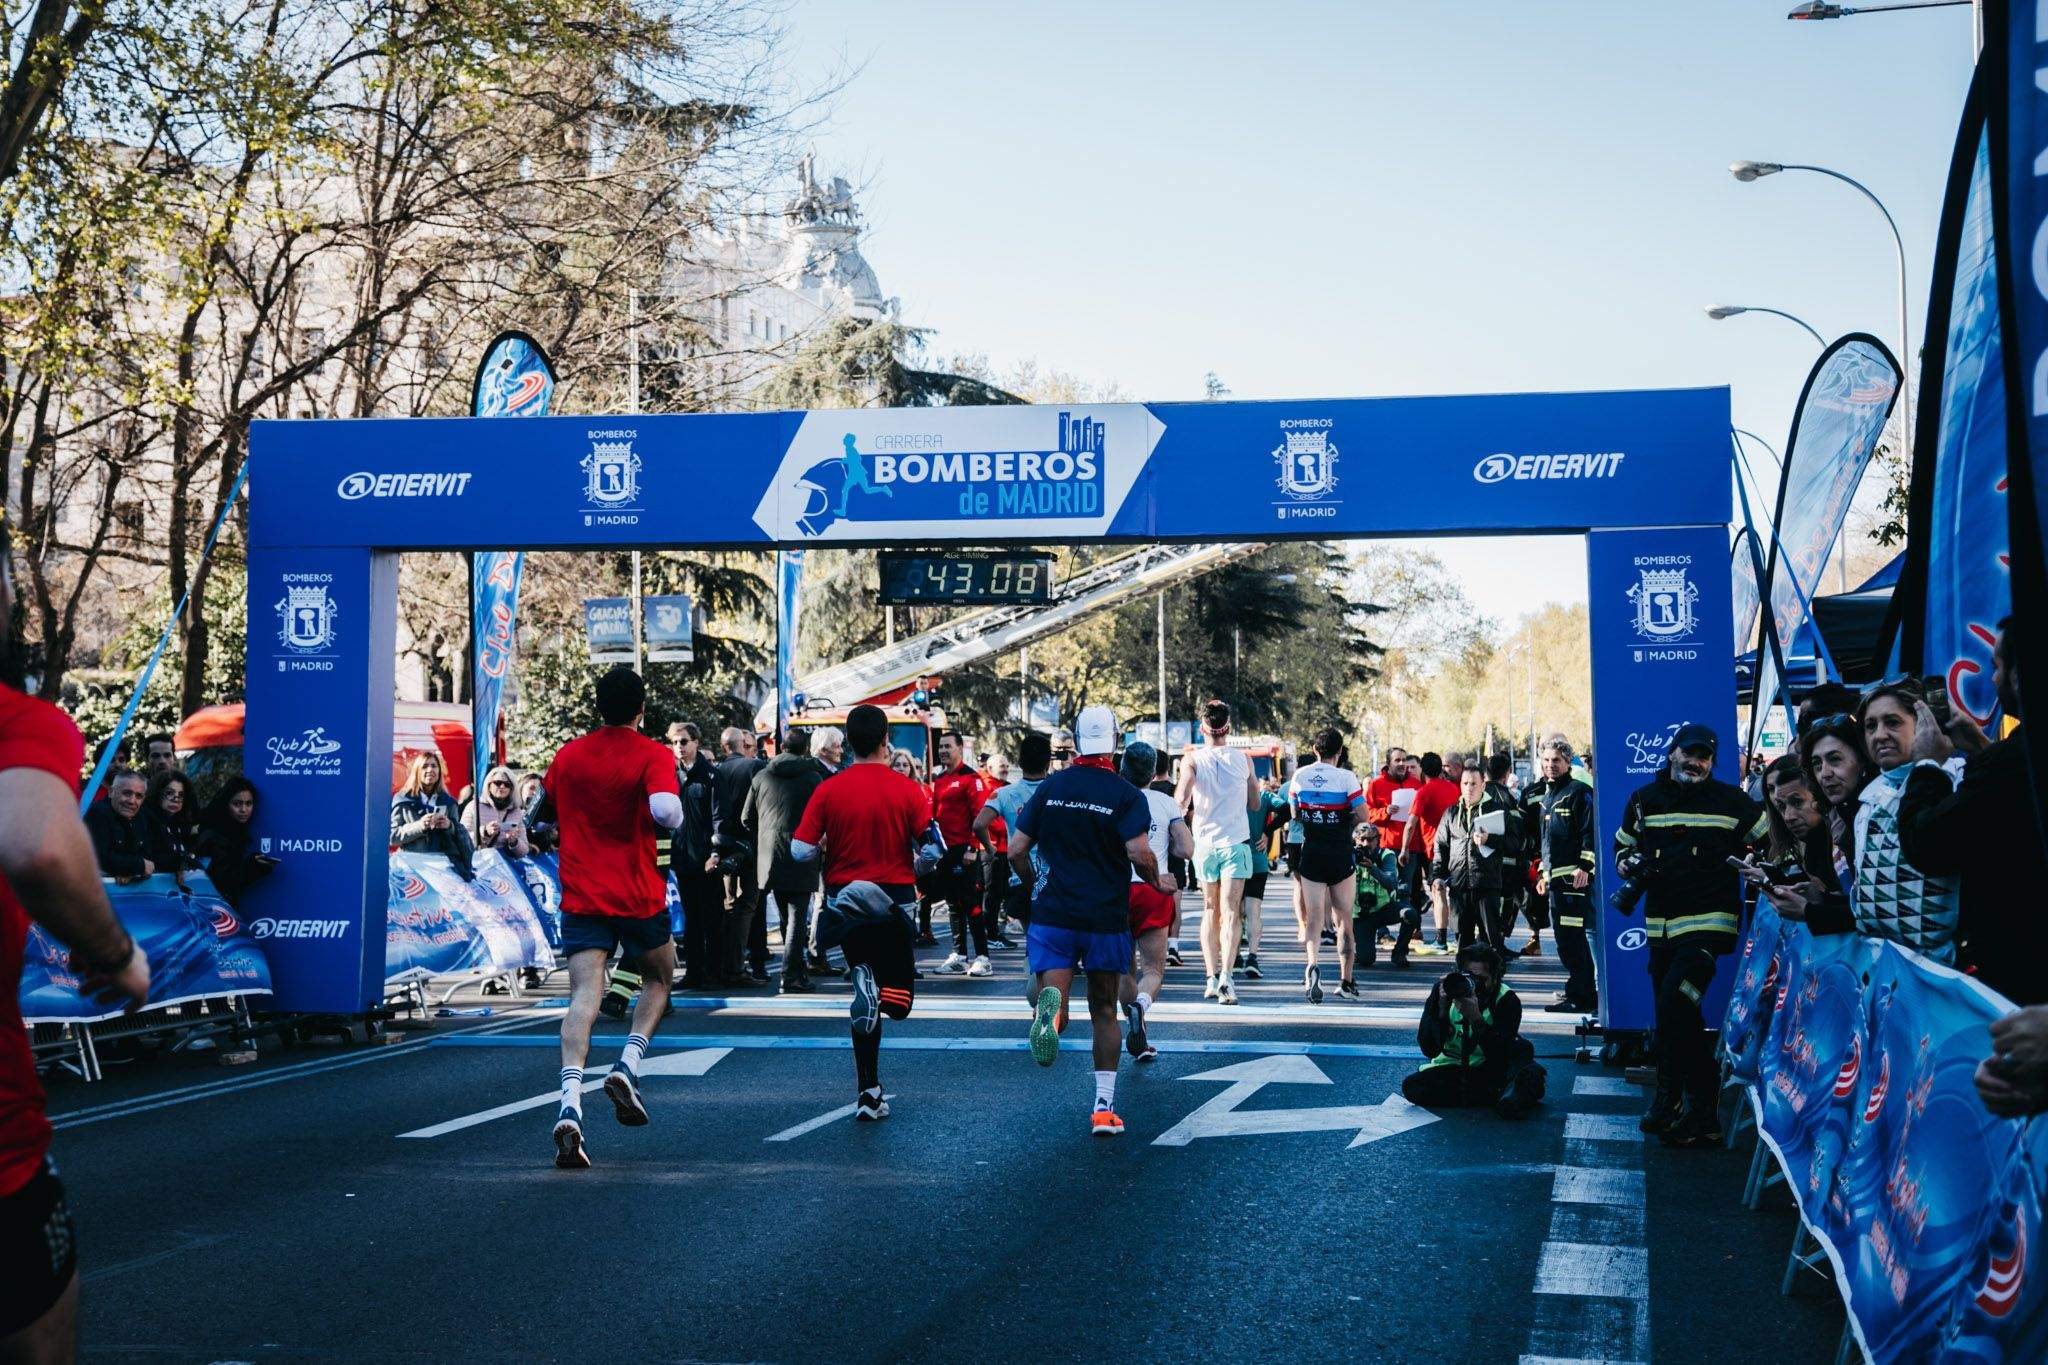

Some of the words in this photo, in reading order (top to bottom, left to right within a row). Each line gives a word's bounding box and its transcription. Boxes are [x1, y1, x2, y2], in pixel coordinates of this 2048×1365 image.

[1280, 418, 1334, 428] BOMBEROS
[587, 429, 638, 439] BOMBEROS
[875, 434, 943, 449] CARRERA
[874, 452, 1097, 484] BOMBEROS
[1514, 452, 1625, 480] ENERVIT
[373, 472, 472, 497] ENERVIT
[959, 484, 989, 515] de
[999, 482, 1098, 515] MADRID
[1291, 507, 1337, 518] MADRID
[597, 515, 640, 525] MADRID
[1634, 555, 1693, 565] BOMBEROS
[282, 573, 333, 583] BOMBEROS
[1648, 650, 1698, 661] MADRID
[291, 661, 334, 671] MADRID
[266, 737, 299, 752] Club
[1625, 733, 1663, 748] Club
[272, 751, 341, 769] Deportivo
[265, 767, 300, 776] bomberos
[303, 767, 313, 776] de
[315, 767, 341, 776] madrid
[1046, 799, 1064, 807] SAN
[1065, 801, 1089, 809] JUAN
[279, 839, 343, 854] MADRID
[273, 919, 351, 939] ENERVIT
